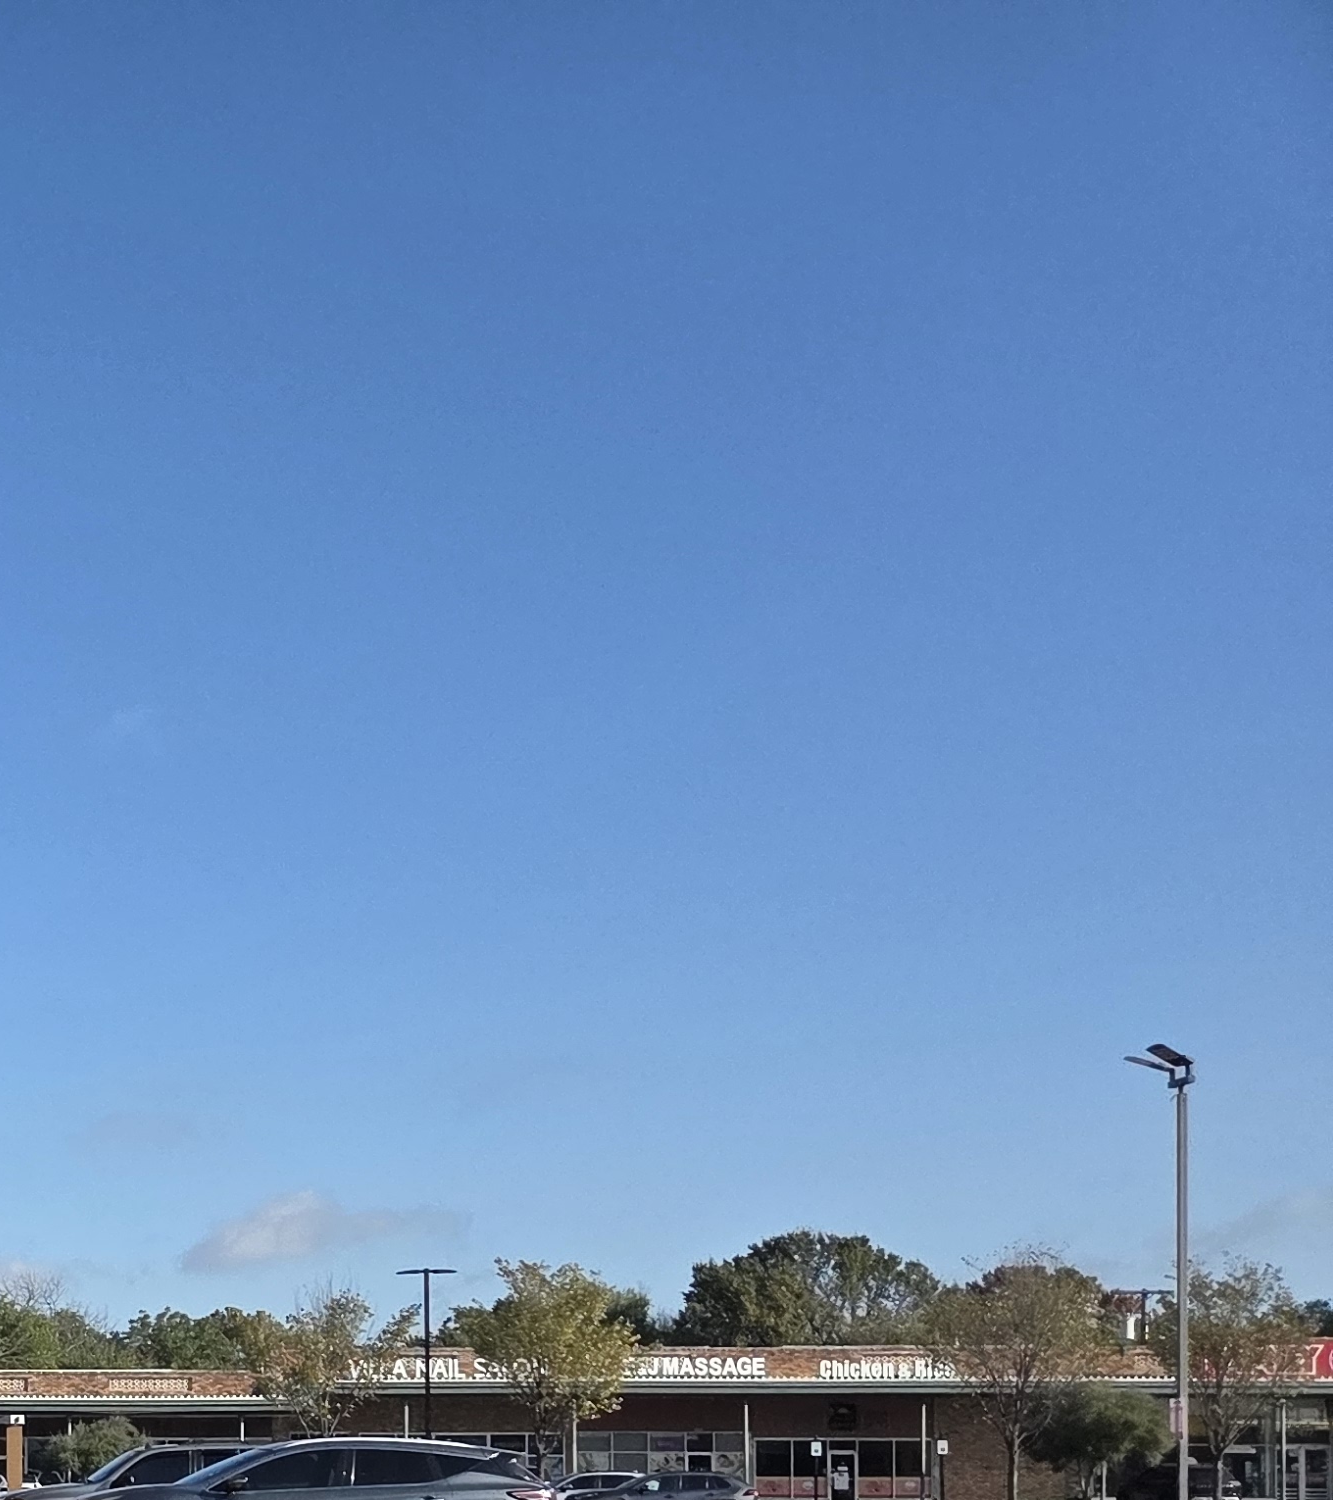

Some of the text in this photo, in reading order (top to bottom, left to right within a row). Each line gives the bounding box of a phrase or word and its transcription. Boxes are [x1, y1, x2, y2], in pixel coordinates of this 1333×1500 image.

[415, 1359, 466, 1379] NAIL
[663, 1357, 766, 1376] MASSAGE
[819, 1359, 893, 1379] Chicken
[898, 1361, 911, 1378] &
